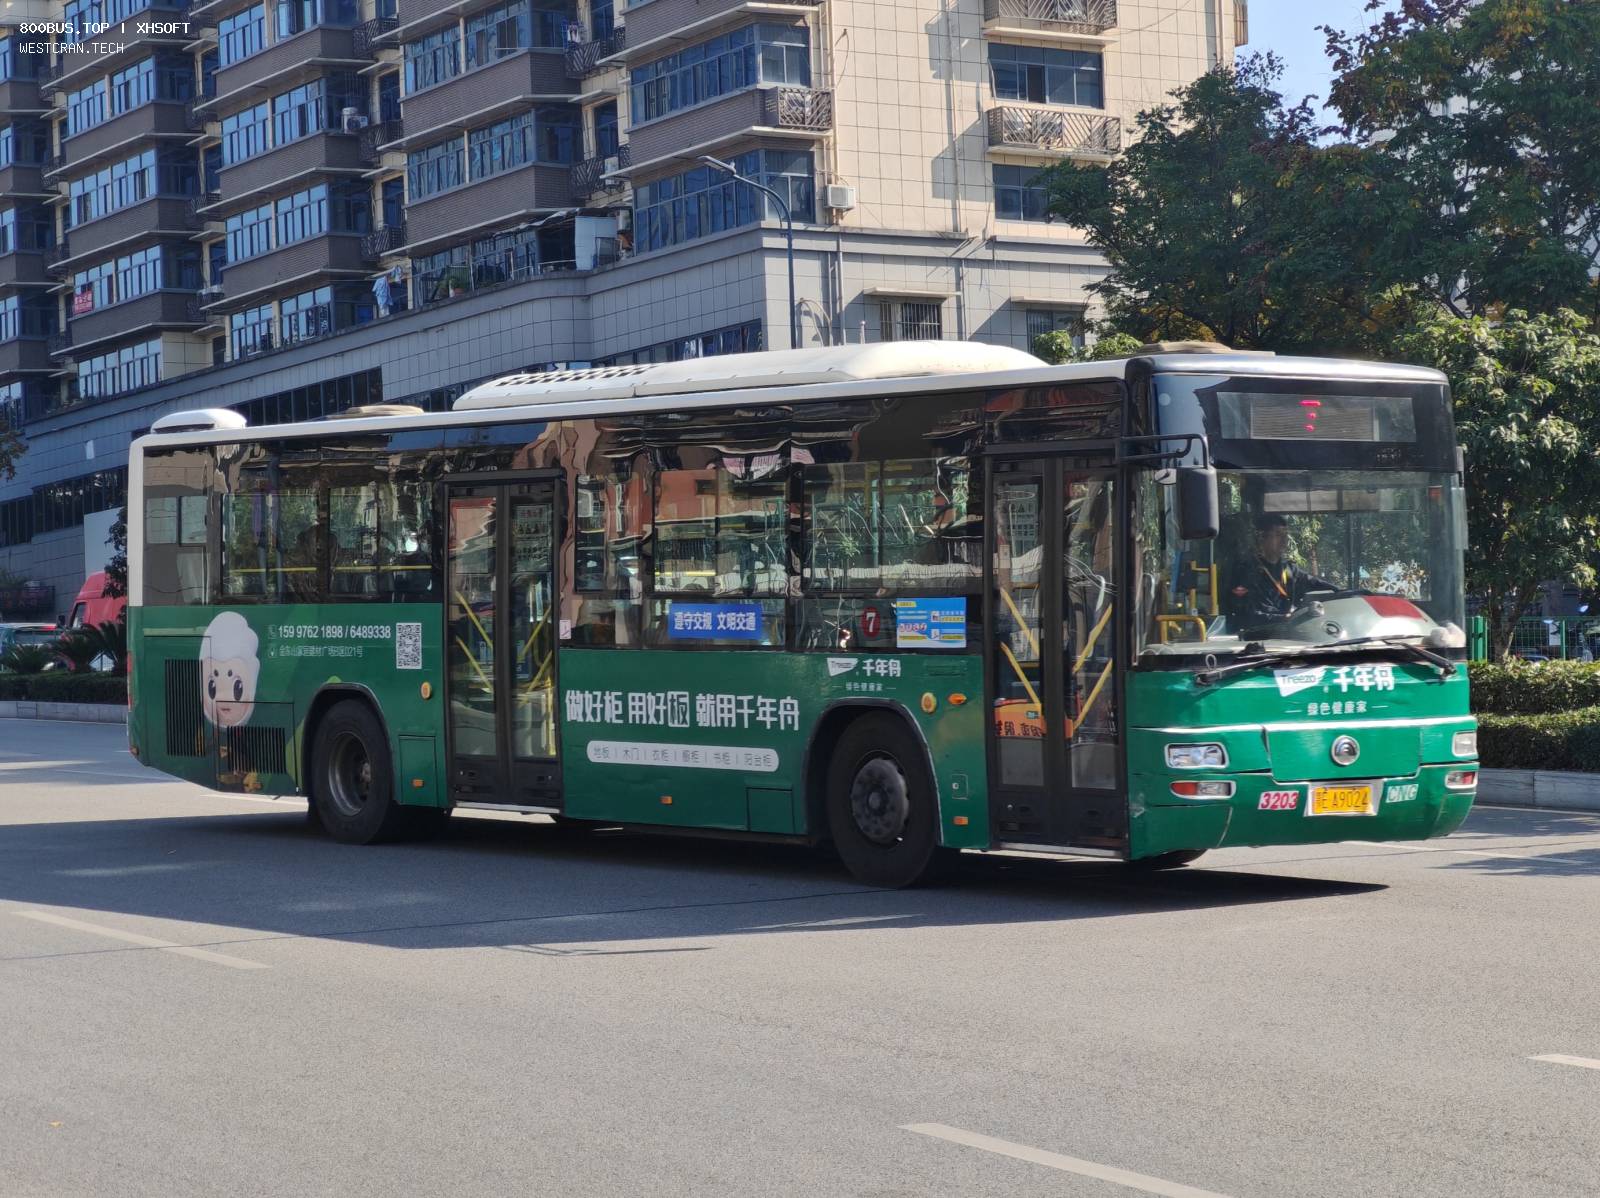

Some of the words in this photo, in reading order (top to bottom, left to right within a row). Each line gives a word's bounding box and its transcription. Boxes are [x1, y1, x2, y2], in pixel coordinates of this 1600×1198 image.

[674, 611, 712, 631] 遵守交规
[716, 611, 756, 632] 文明交通
[865, 611, 876, 633] 7
[279, 625, 294, 639] 159
[297, 625, 318, 639] 9762
[321, 625, 343, 639] 1898
[350, 625, 391, 639] 6489338
[565, 690, 623, 724] 做好柜
[627, 691, 690, 727] 用好板
[696, 693, 800, 731] 就用千年舟
[1307, 700, 1367, 716] 绿色健康家
[1260, 792, 1299, 811] 3203
